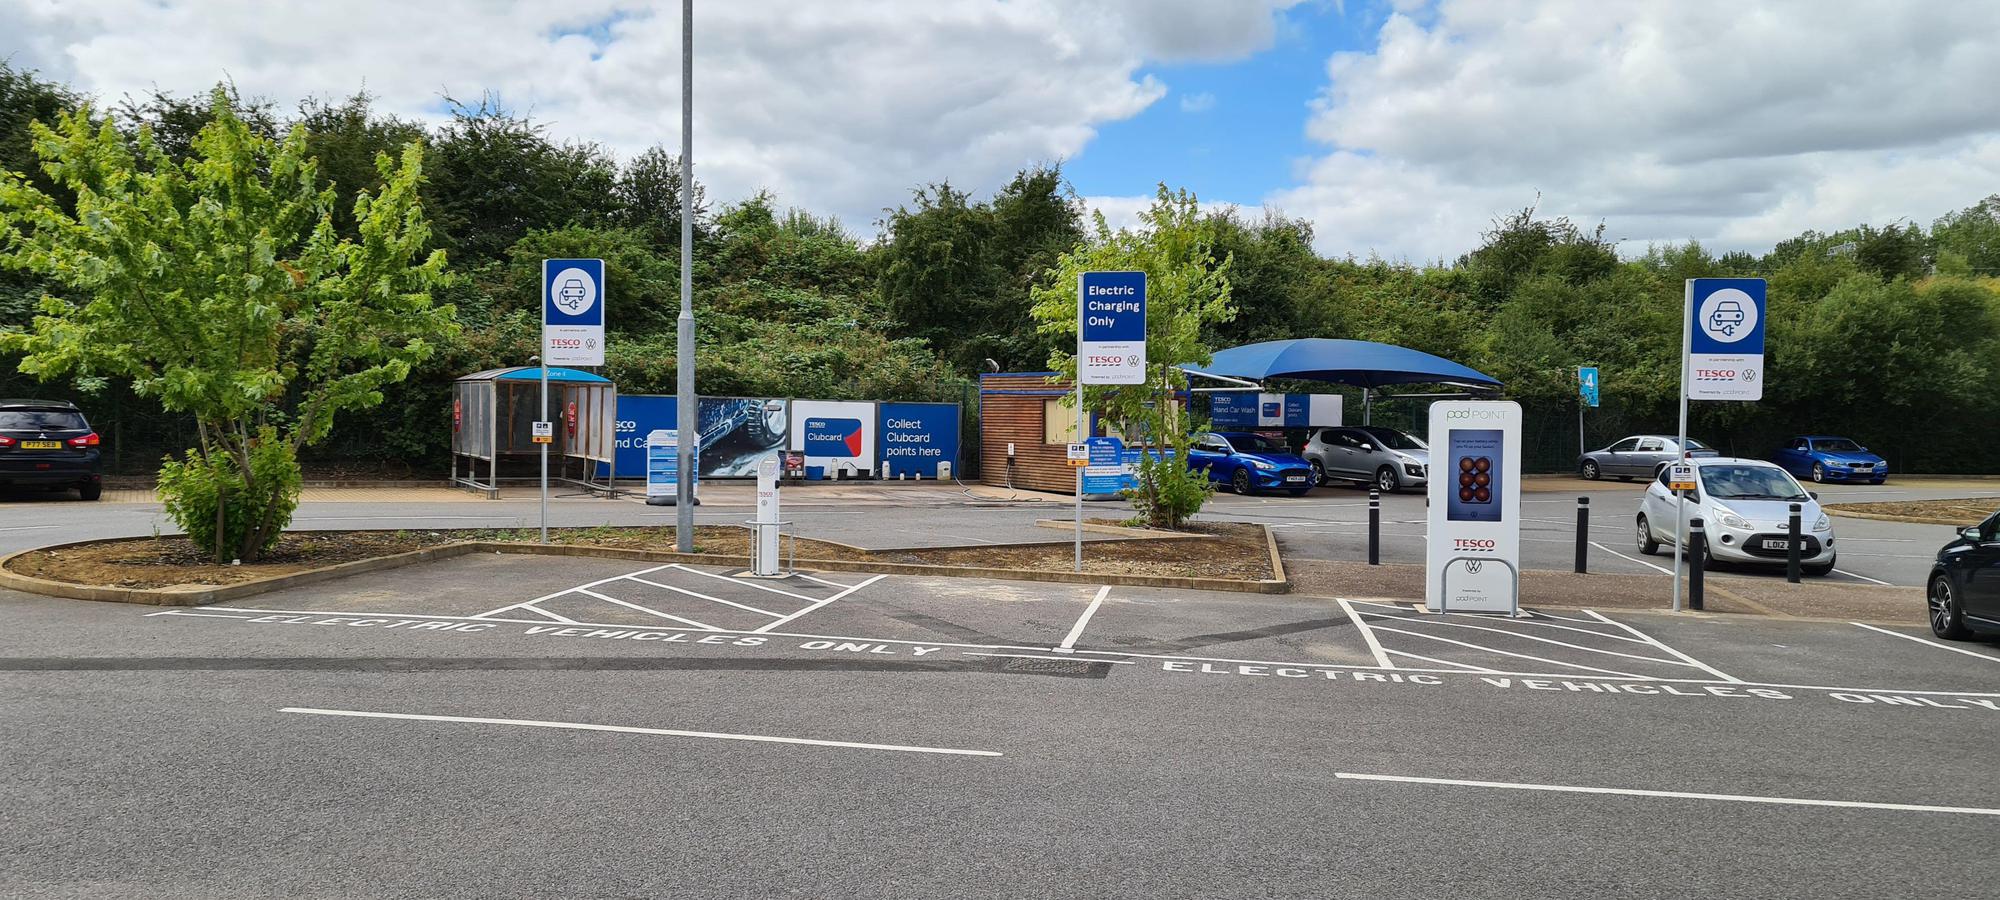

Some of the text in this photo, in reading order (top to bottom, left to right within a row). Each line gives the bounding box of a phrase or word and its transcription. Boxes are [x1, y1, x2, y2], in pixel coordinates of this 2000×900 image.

[1088, 285, 1134, 296] Electric
[1088, 300, 1140, 312] Charging
[1088, 316, 1115, 328] Only
[1088, 356, 1122, 364] TESCO
[1696, 369, 1736, 378] TESCO
[1585, 373, 1594, 387] 4
[1446, 408, 1508, 422] pod POINT
[615, 420, 637, 429] SCO
[887, 418, 921, 429] Collect
[808, 432, 842, 441] Clubcard
[887, 432, 930, 443] Clubcard
[615, 437, 647, 449] nd Ca
[887, 447, 942, 458] points here
[1453, 539, 1495, 548] TESCO
[248, 615, 942, 656] ELECTRIC VEHICLES ONLY
[1162, 661, 2000, 711] ELECTRIC VEHICLES ONLY
